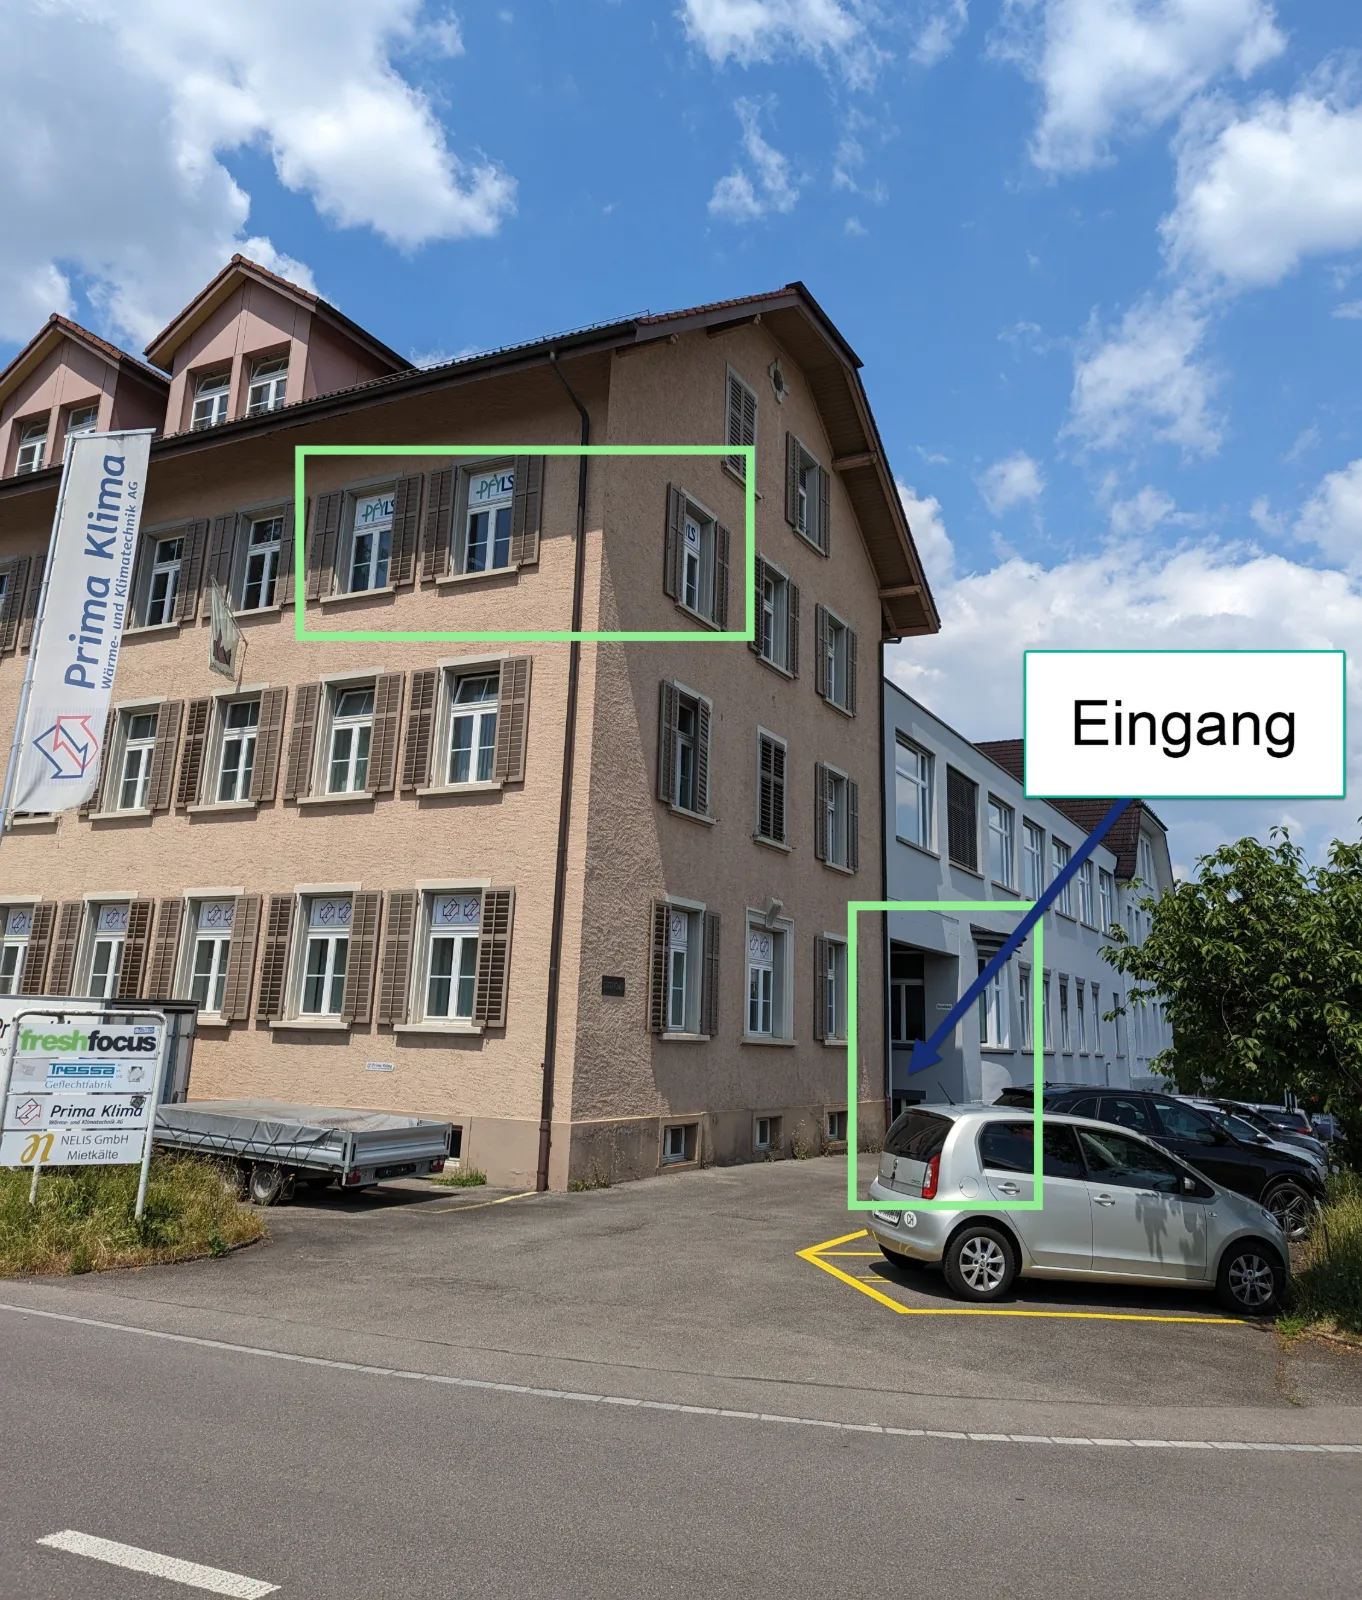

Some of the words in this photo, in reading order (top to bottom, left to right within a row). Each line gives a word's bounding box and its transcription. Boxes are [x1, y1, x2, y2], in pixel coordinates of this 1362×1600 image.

[128, 481, 138, 500] AG
[84, 454, 126, 560] Klima
[114, 504, 136, 598] Klimatechnik
[113, 602, 125, 630] und
[64, 575, 111, 690] Prima
[101, 635, 119, 689] Wärme-
[20, 1029, 157, 1052] freshfocus
[49, 1063, 115, 1076] Tressa
[44, 1080, 113, 1090] Geflechtfabrik
[50, 1104, 96, 1118] Prima
[100, 1104, 143, 1118] Klima
[60, 1135, 92, 1145] NELIS
[94, 1134, 129, 1145] GmbH
[67, 1149, 119, 1161] Mietkälte
[906, 1213, 915, 1226] CH
